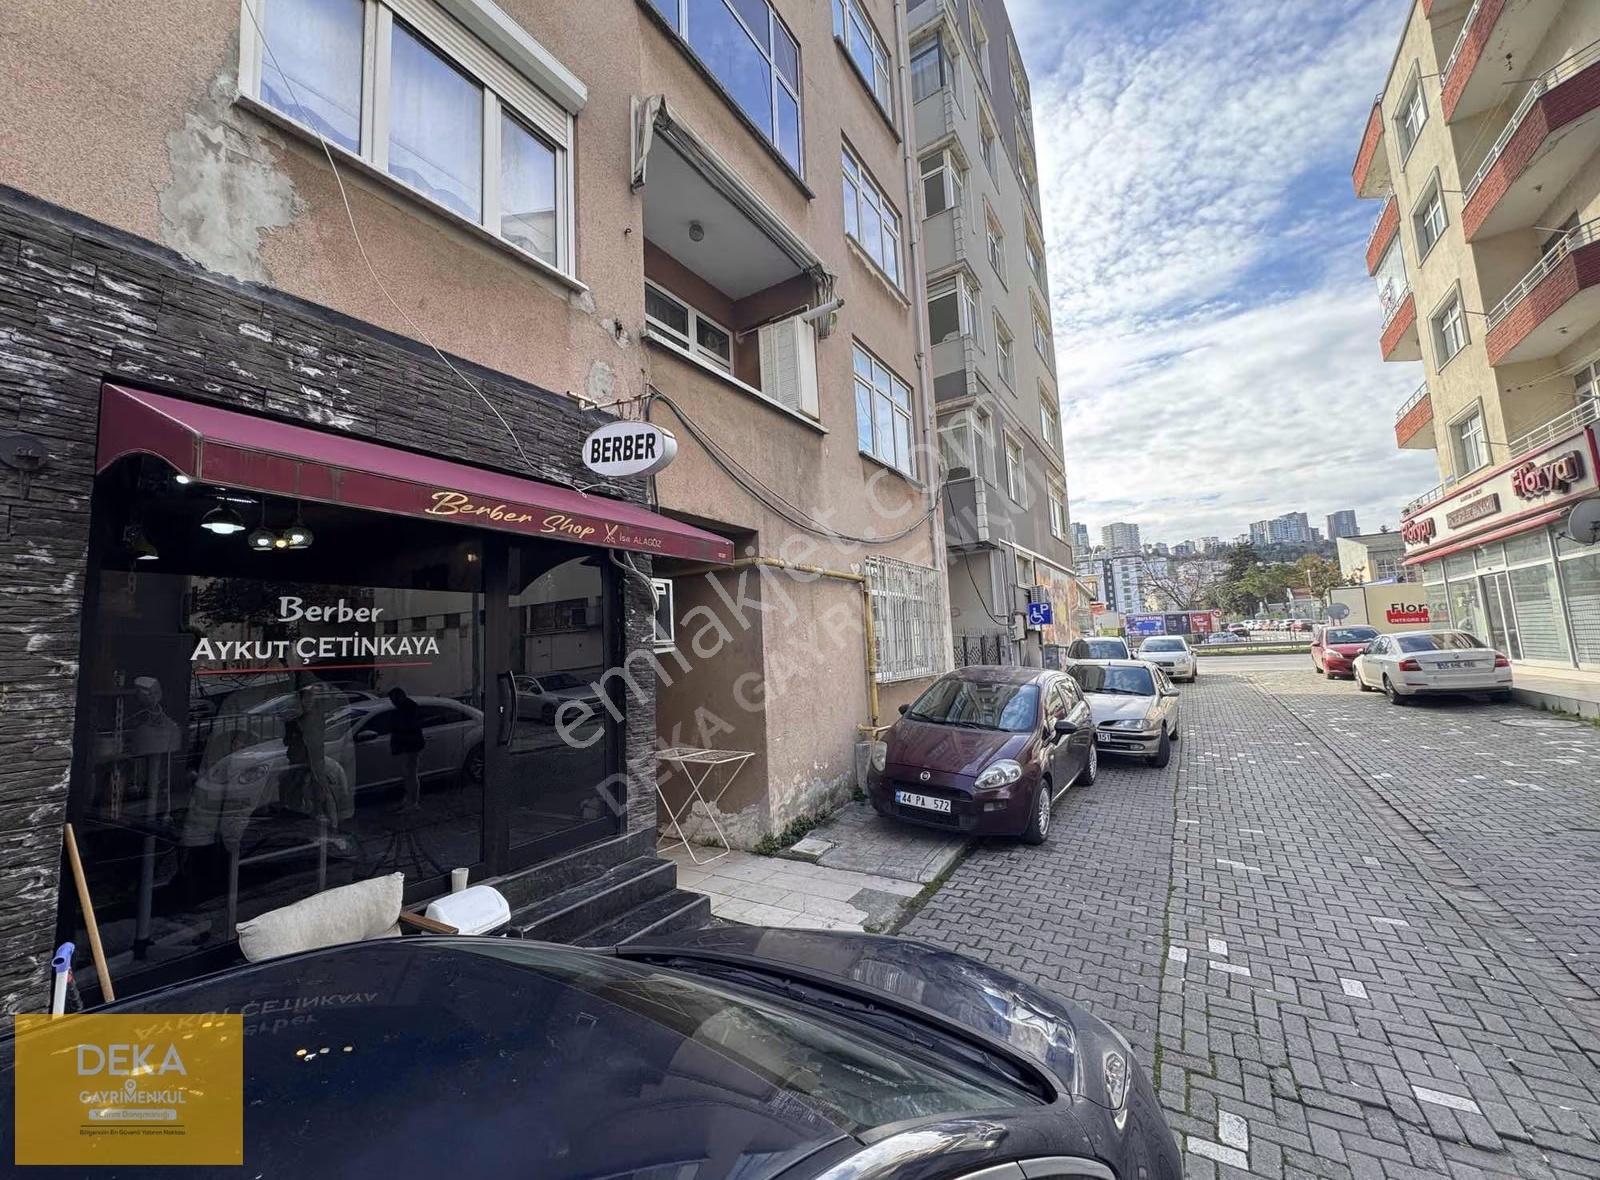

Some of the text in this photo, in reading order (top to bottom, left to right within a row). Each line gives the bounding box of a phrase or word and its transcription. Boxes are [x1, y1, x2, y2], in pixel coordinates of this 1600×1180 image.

[590, 432, 657, 464] BERBER
[424, 491, 533, 523] Berber
[540, 514, 596, 540] Shop
[277, 596, 384, 623] Berber
[1040, 603, 1049, 615] P
[1391, 602, 1428, 613] Flor
[190, 631, 440, 665] AYKUT ÇETİNKAYA
[901, 793, 950, 811] 44 PA 572
